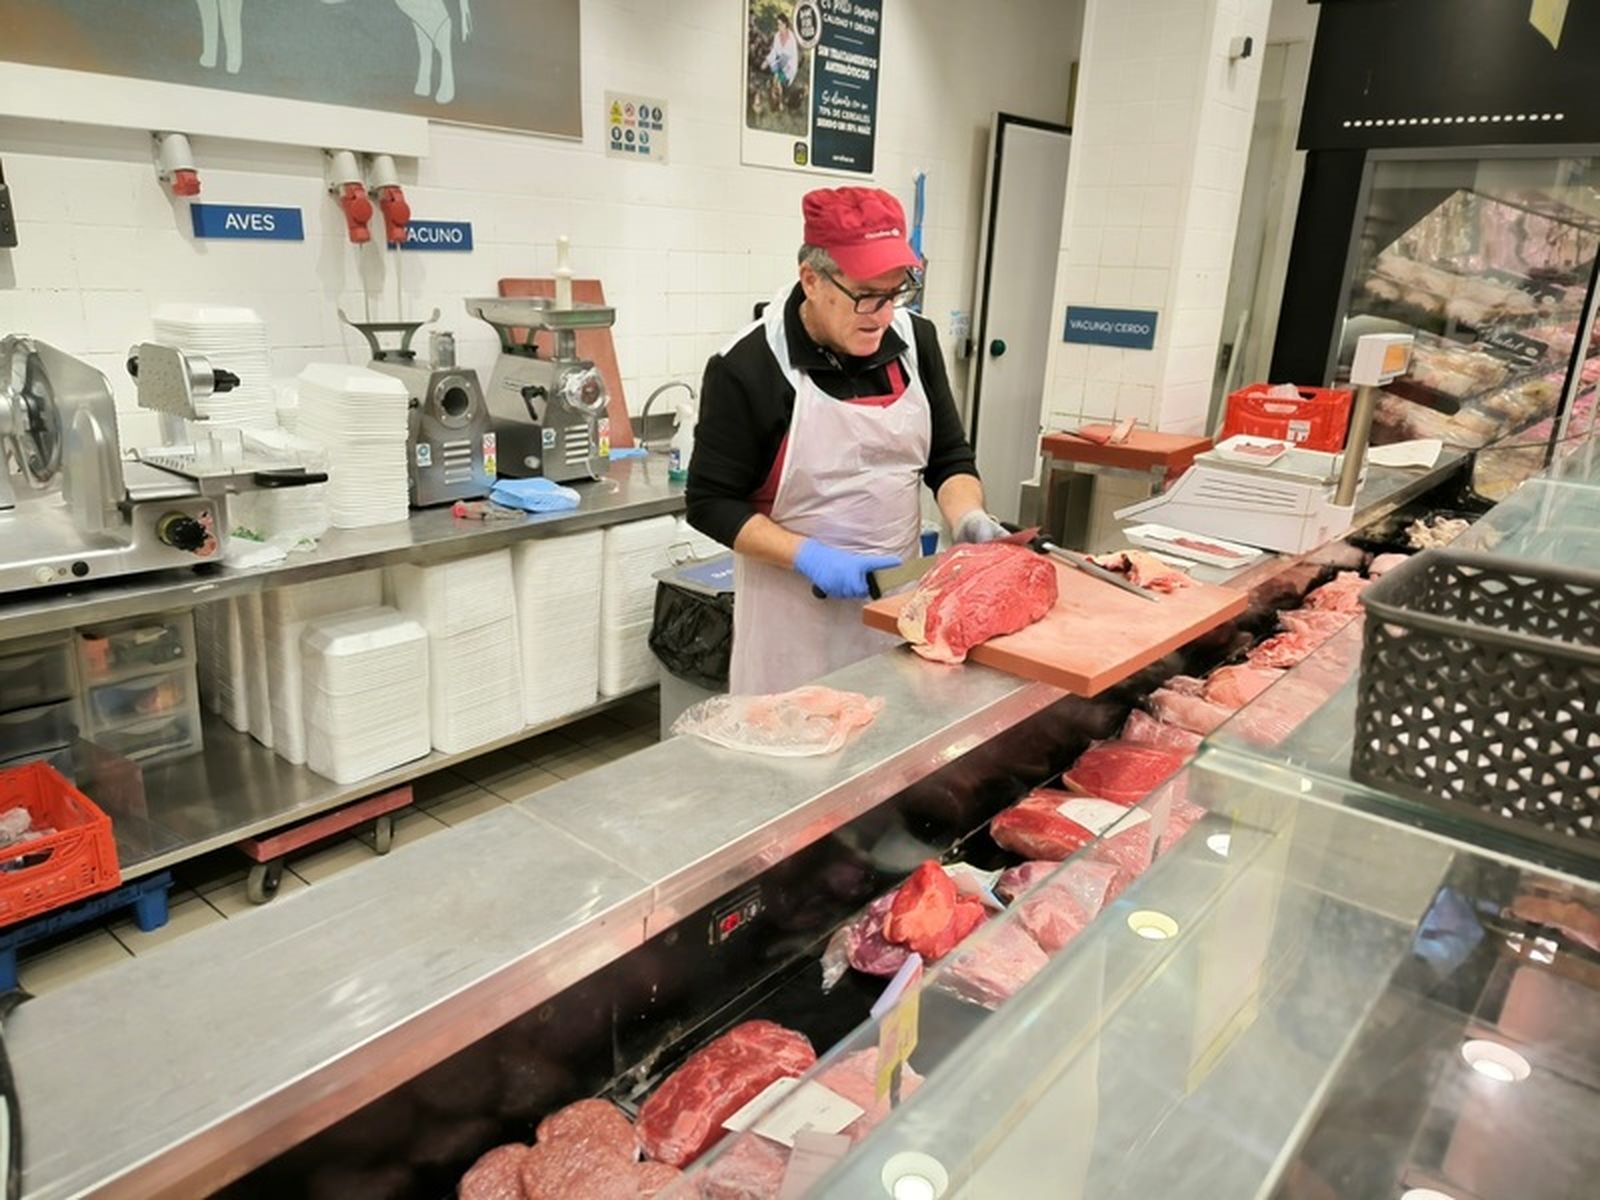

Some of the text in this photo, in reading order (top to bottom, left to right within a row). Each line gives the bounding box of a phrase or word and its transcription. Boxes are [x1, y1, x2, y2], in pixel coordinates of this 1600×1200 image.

[225, 213, 275, 231] AVES
[402, 227, 463, 244] ACUNO
[1070, 320, 1150, 335] VACUNO/ CERDO
